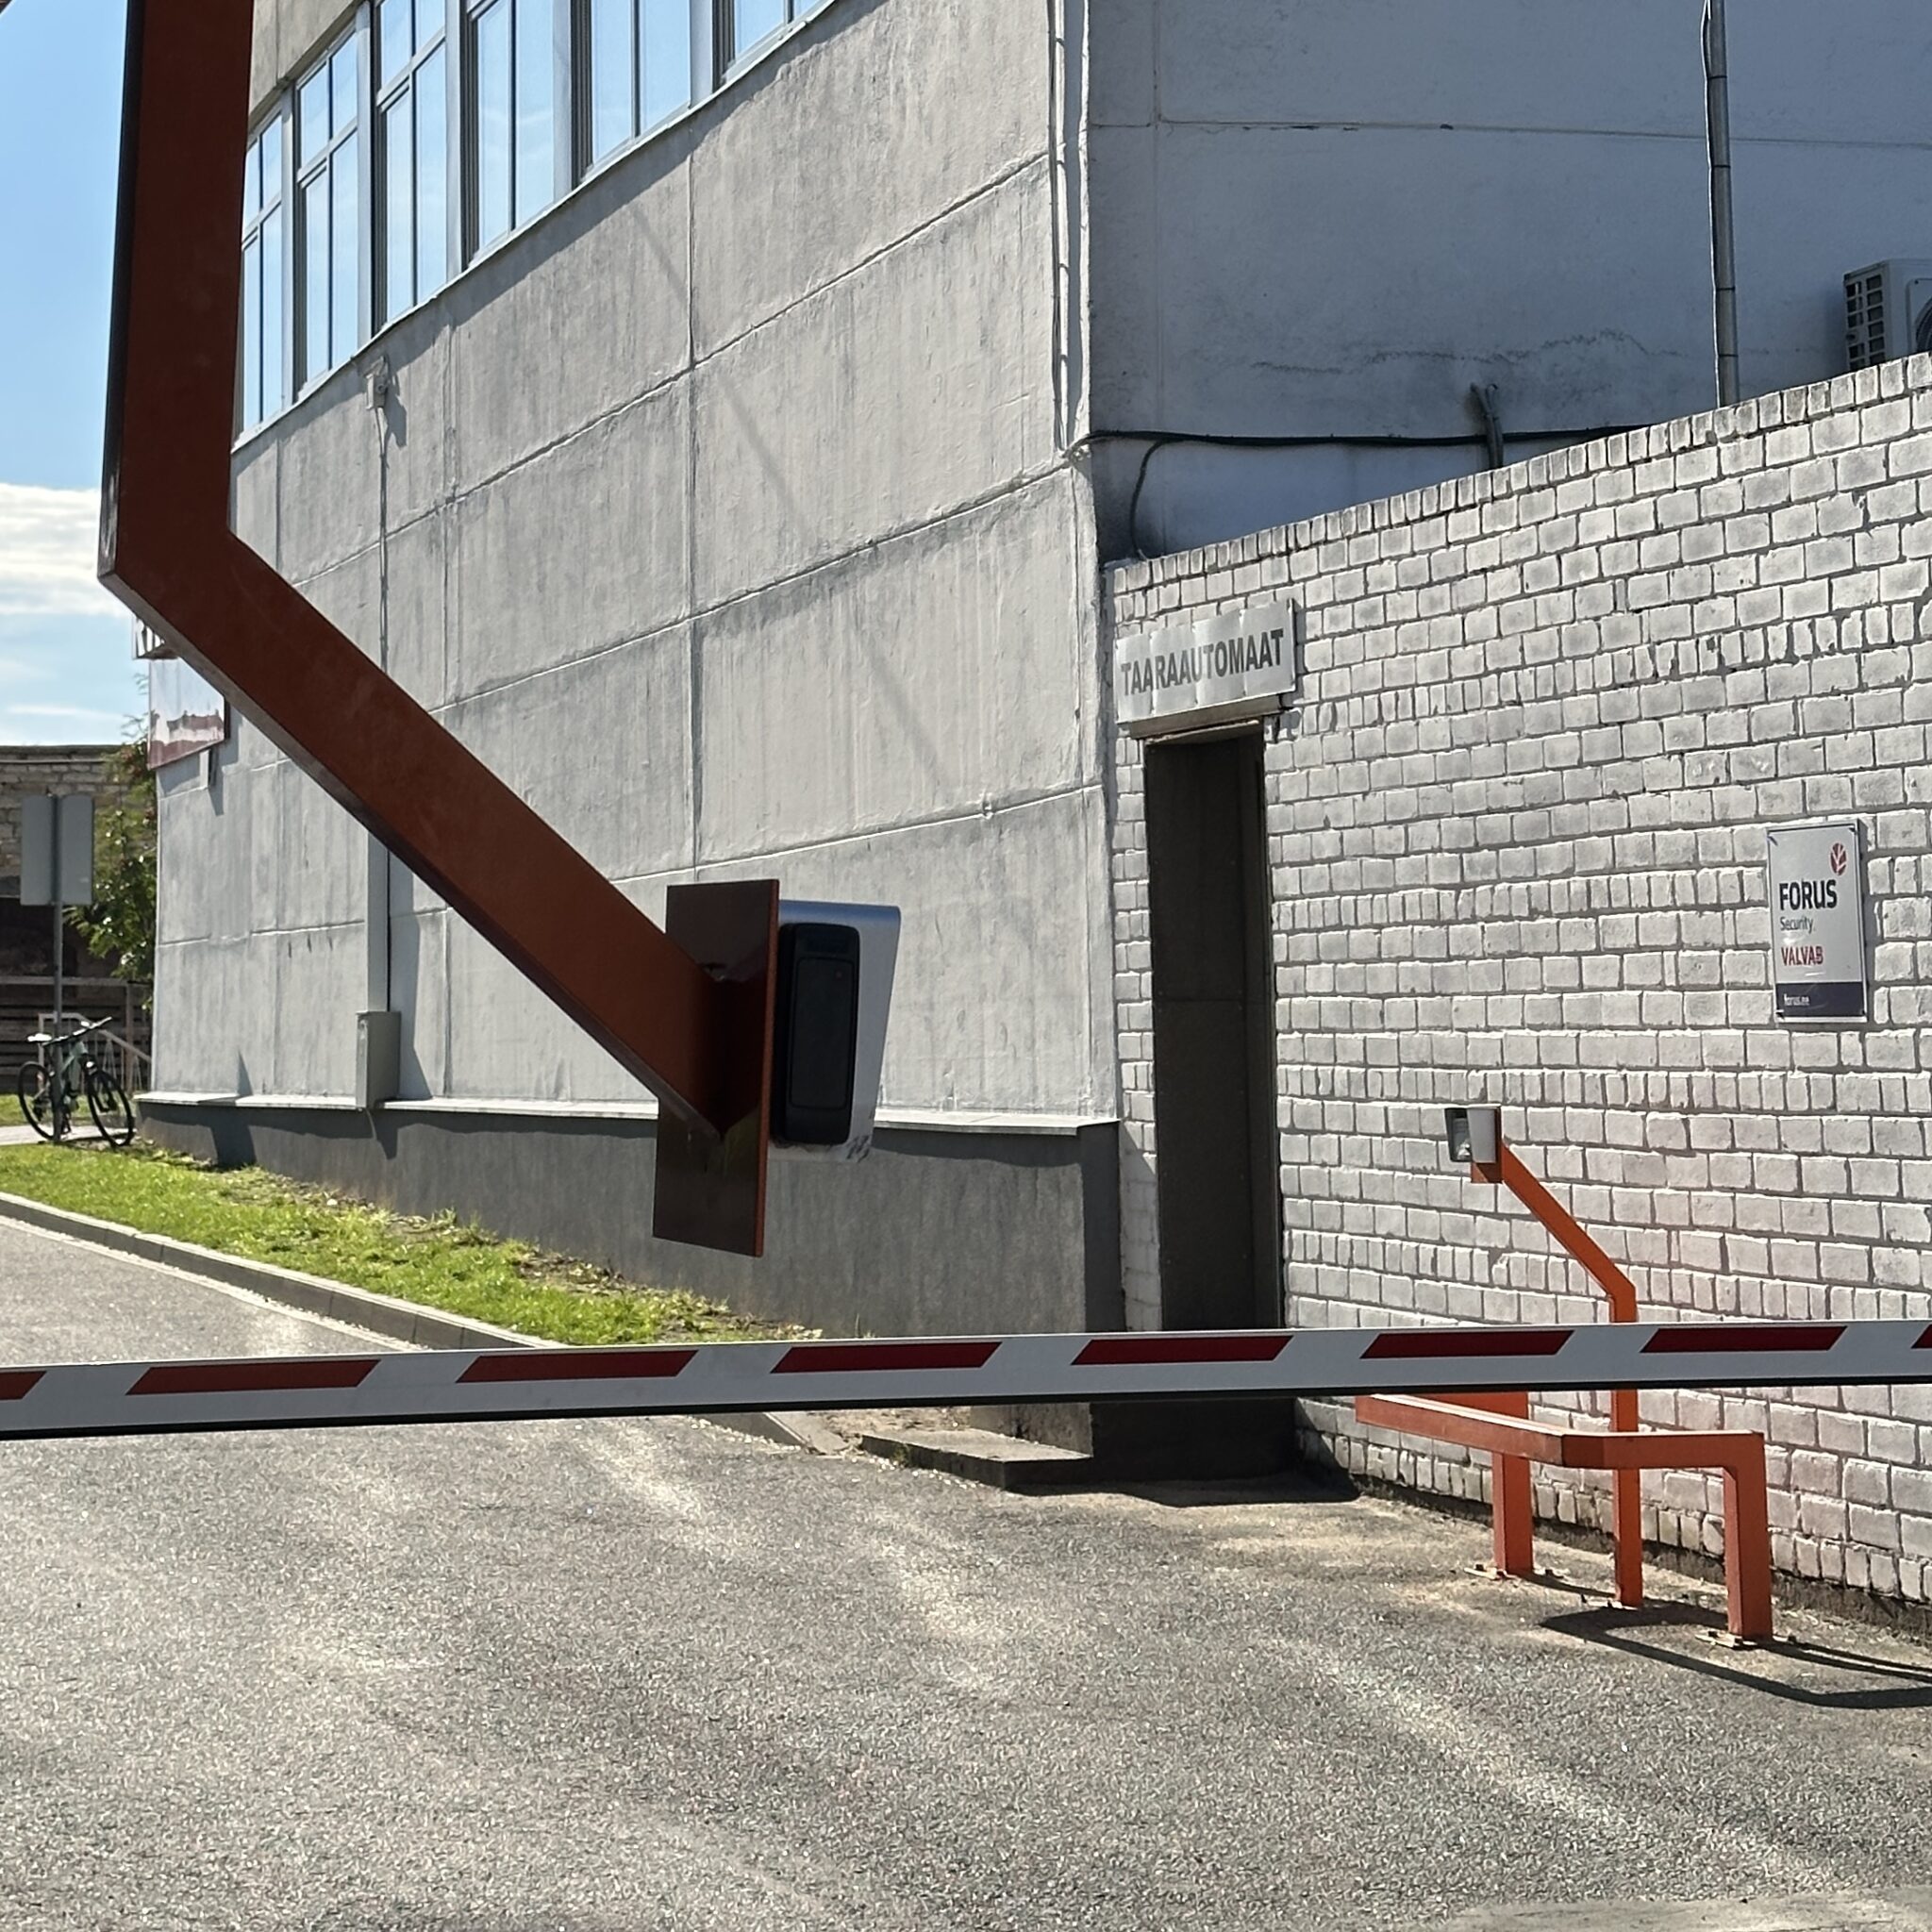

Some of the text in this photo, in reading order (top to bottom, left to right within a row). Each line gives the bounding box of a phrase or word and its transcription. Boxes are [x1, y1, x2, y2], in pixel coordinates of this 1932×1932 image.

[1121, 628, 1284, 696] TAARAAUTOMAAT
[1779, 878, 1837, 910] FORUS
[1781, 945, 1824, 966] VALVAB
